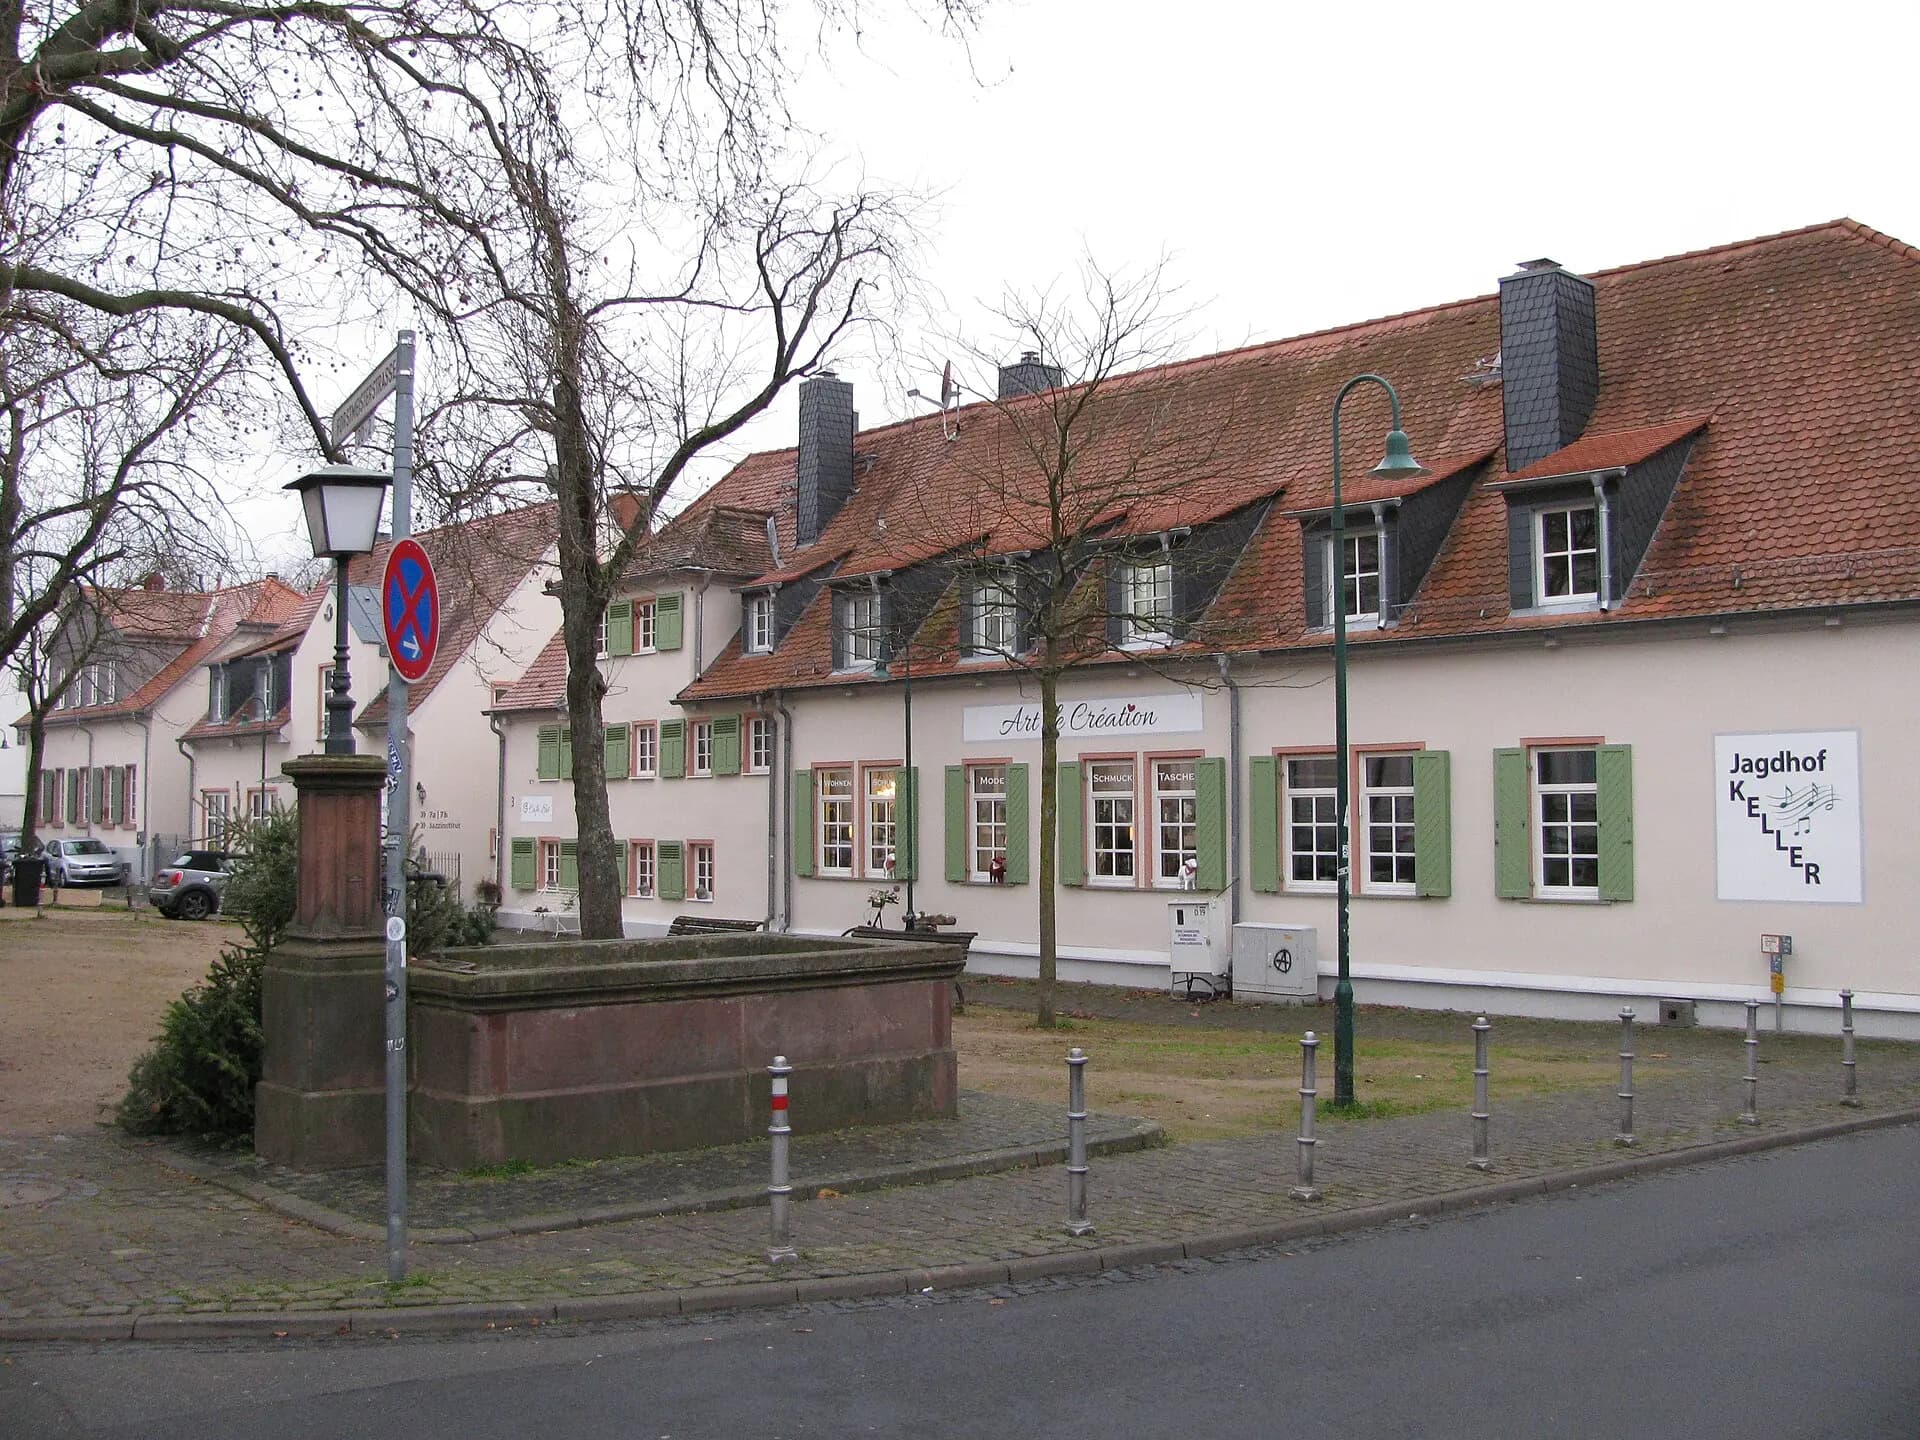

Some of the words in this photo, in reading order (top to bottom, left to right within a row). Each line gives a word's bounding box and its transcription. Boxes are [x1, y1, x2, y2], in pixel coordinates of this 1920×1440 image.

[999, 707, 1040, 735] Art
[1070, 702, 1158, 731] Création
[1093, 773, 1133, 783] SCHMUCK
[1729, 749, 1827, 779] Jagdhof
[980, 776, 1005, 785] MODE
[1729, 780, 1821, 884] KELLER
